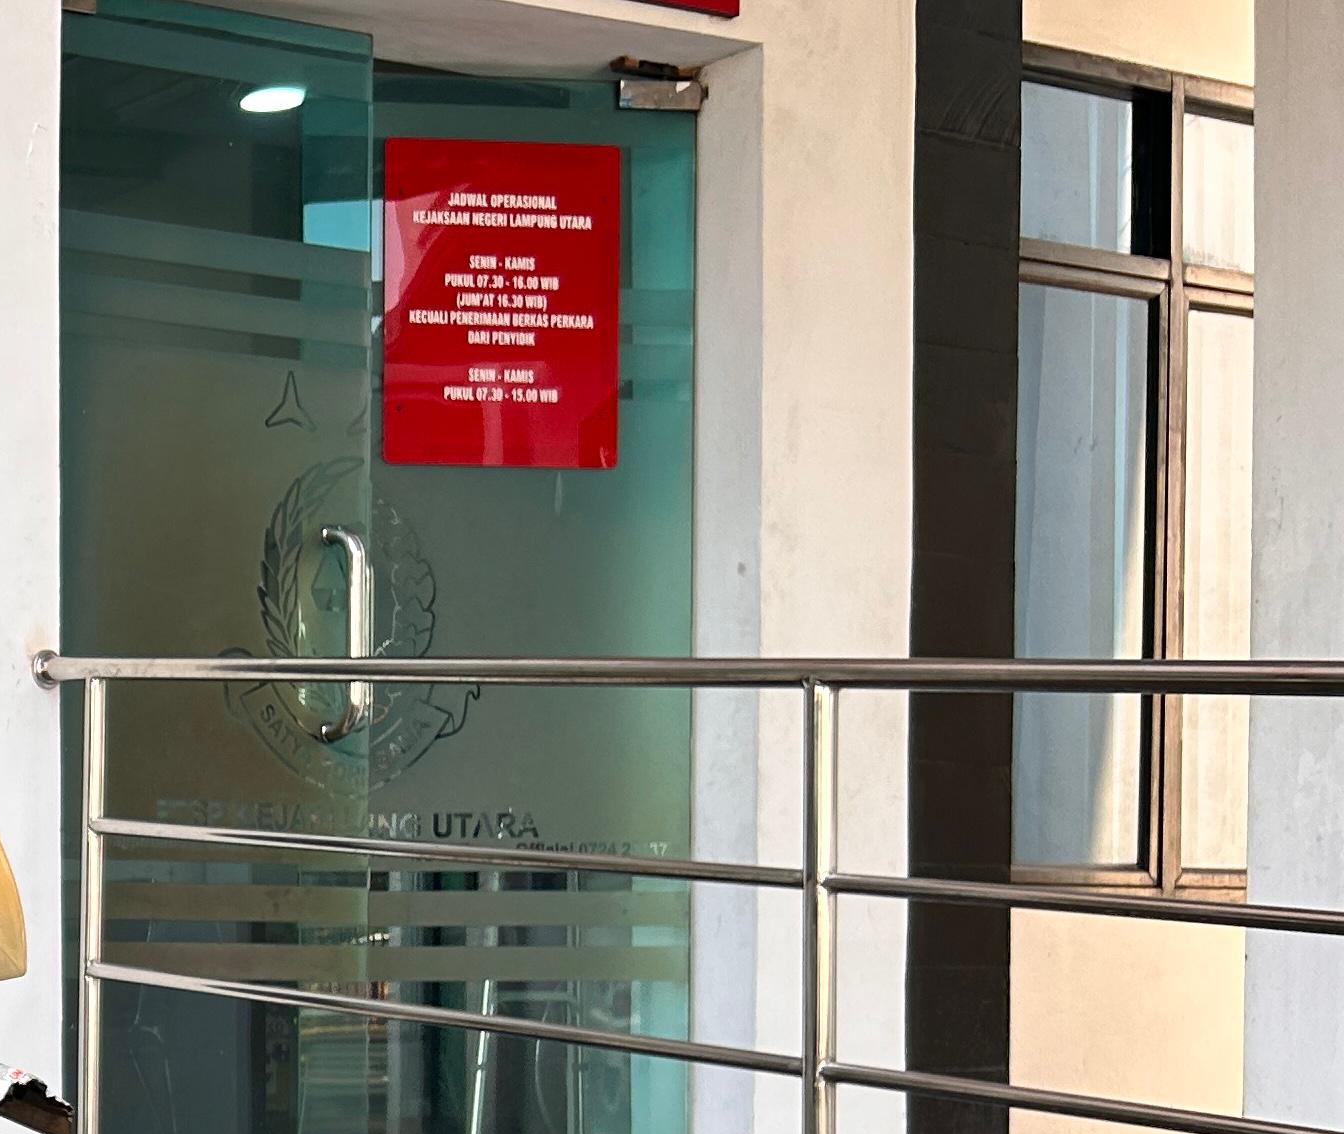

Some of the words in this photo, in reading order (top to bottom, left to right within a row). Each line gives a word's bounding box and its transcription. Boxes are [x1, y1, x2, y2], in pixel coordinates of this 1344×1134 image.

[448, 192, 488, 207] JADWAL
[490, 193, 557, 210] OPERASIONAL
[413, 210, 470, 226] KEJAKSAAN
[472, 212, 507, 227] NEGERI
[509, 213, 558, 229] LAMPUNG
[559, 215, 592, 231] UTARA
[469, 255, 497, 270] SENIN
[504, 256, 535, 271] KAMIS
[444, 273, 475, 288] PUKUL
[476, 274, 504, 289] 07.30
[512, 275, 539, 290] 16.00
[540, 276, 560, 291] WIB
[497, 293, 523, 309] 16.30
[525, 294, 547, 312] WIB)
[409, 309, 448, 324] KECUALI
[449, 310, 510, 326] PENERIMAAN
[512, 312, 549, 328] BERKAS
[550, 314, 593, 330] PERKARA
[468, 330, 490, 345] DARI
[492, 331, 535, 346] PENYIDIK
[468, 368, 496, 382] SENIN
[503, 369, 534, 384] KAMIS
[444, 386, 474, 401] PUKUL
[475, 387, 504, 402] 07.30
[512, 388, 538, 403] 15.00
[538, 389, 558, 403] WIB
[432, 811, 539, 839] UTARA
